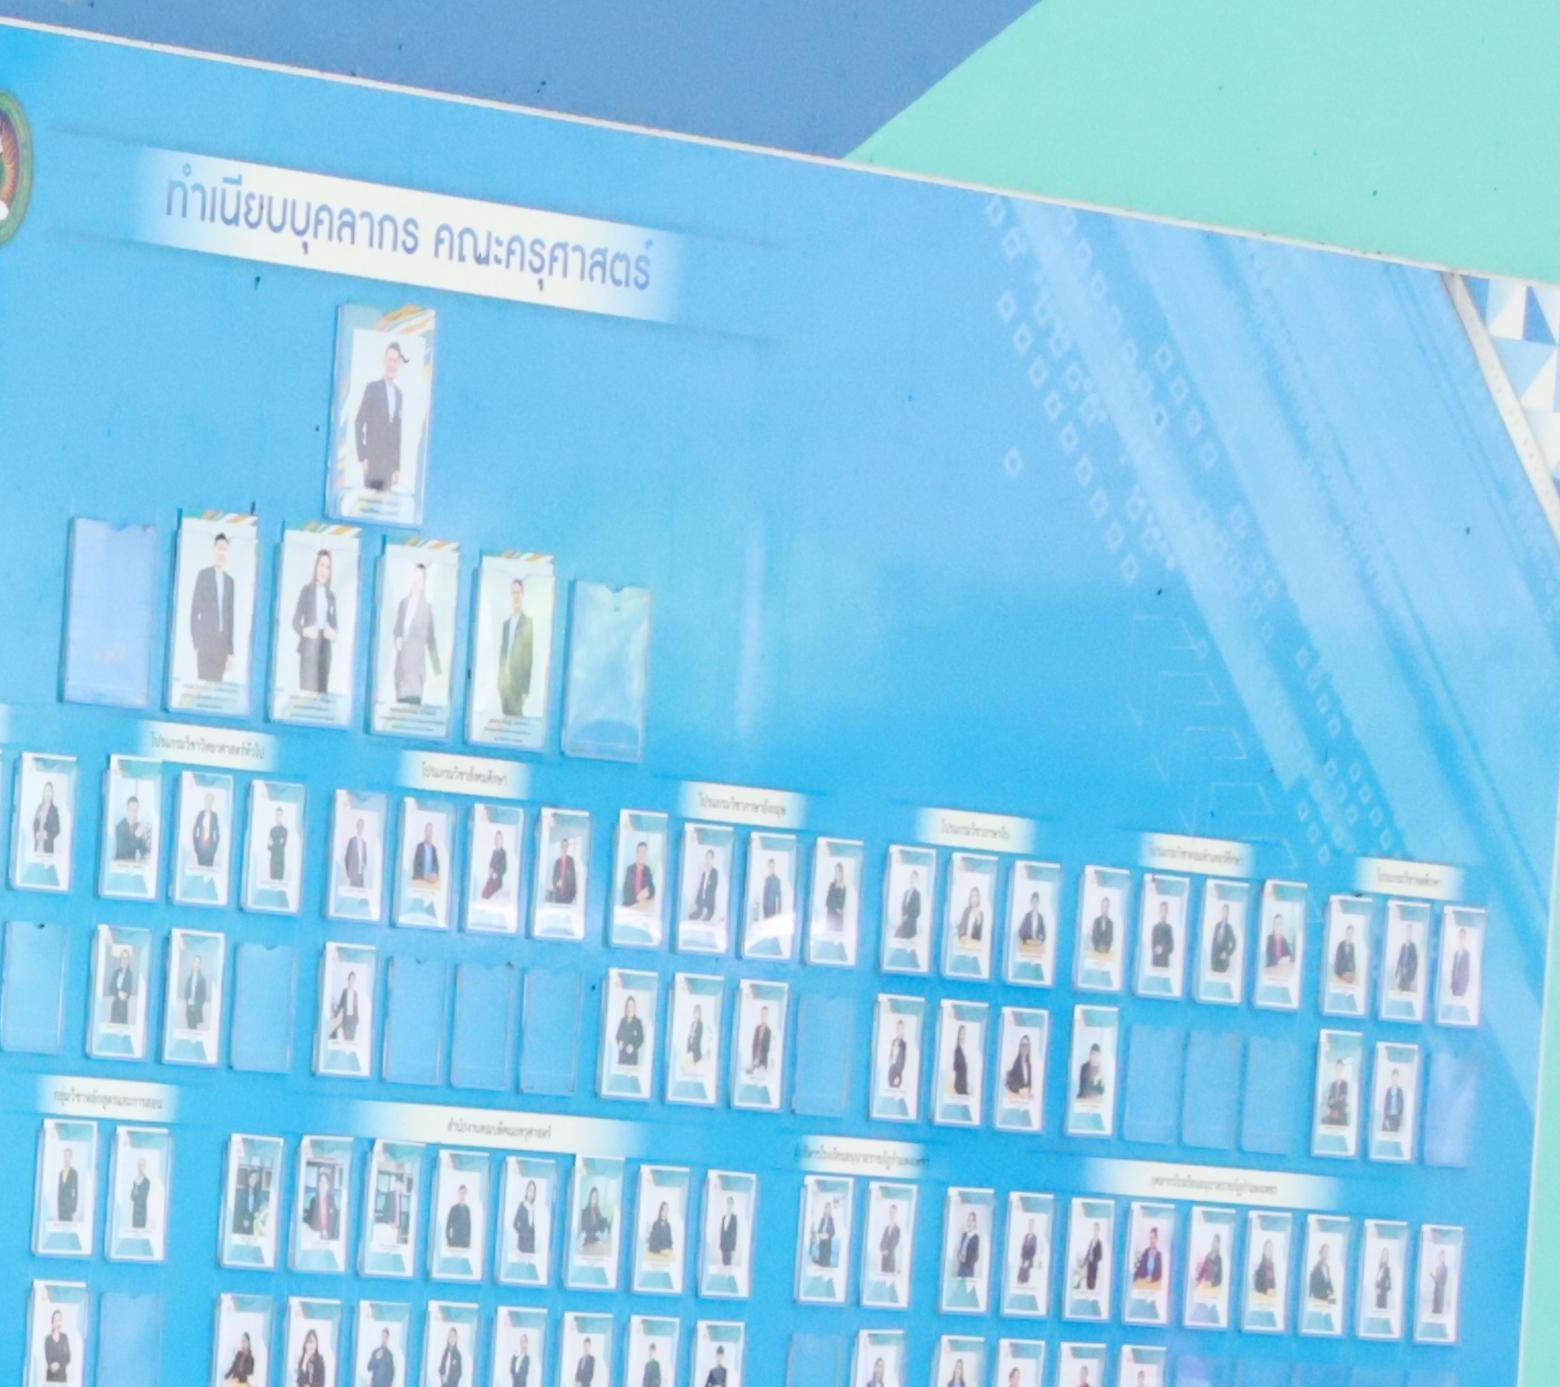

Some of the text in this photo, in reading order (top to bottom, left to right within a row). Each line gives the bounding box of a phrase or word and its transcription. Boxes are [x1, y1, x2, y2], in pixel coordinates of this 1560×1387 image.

[165, 162, 653, 291] ทำเนียบบุคลากร คณะครุศาสตร์
